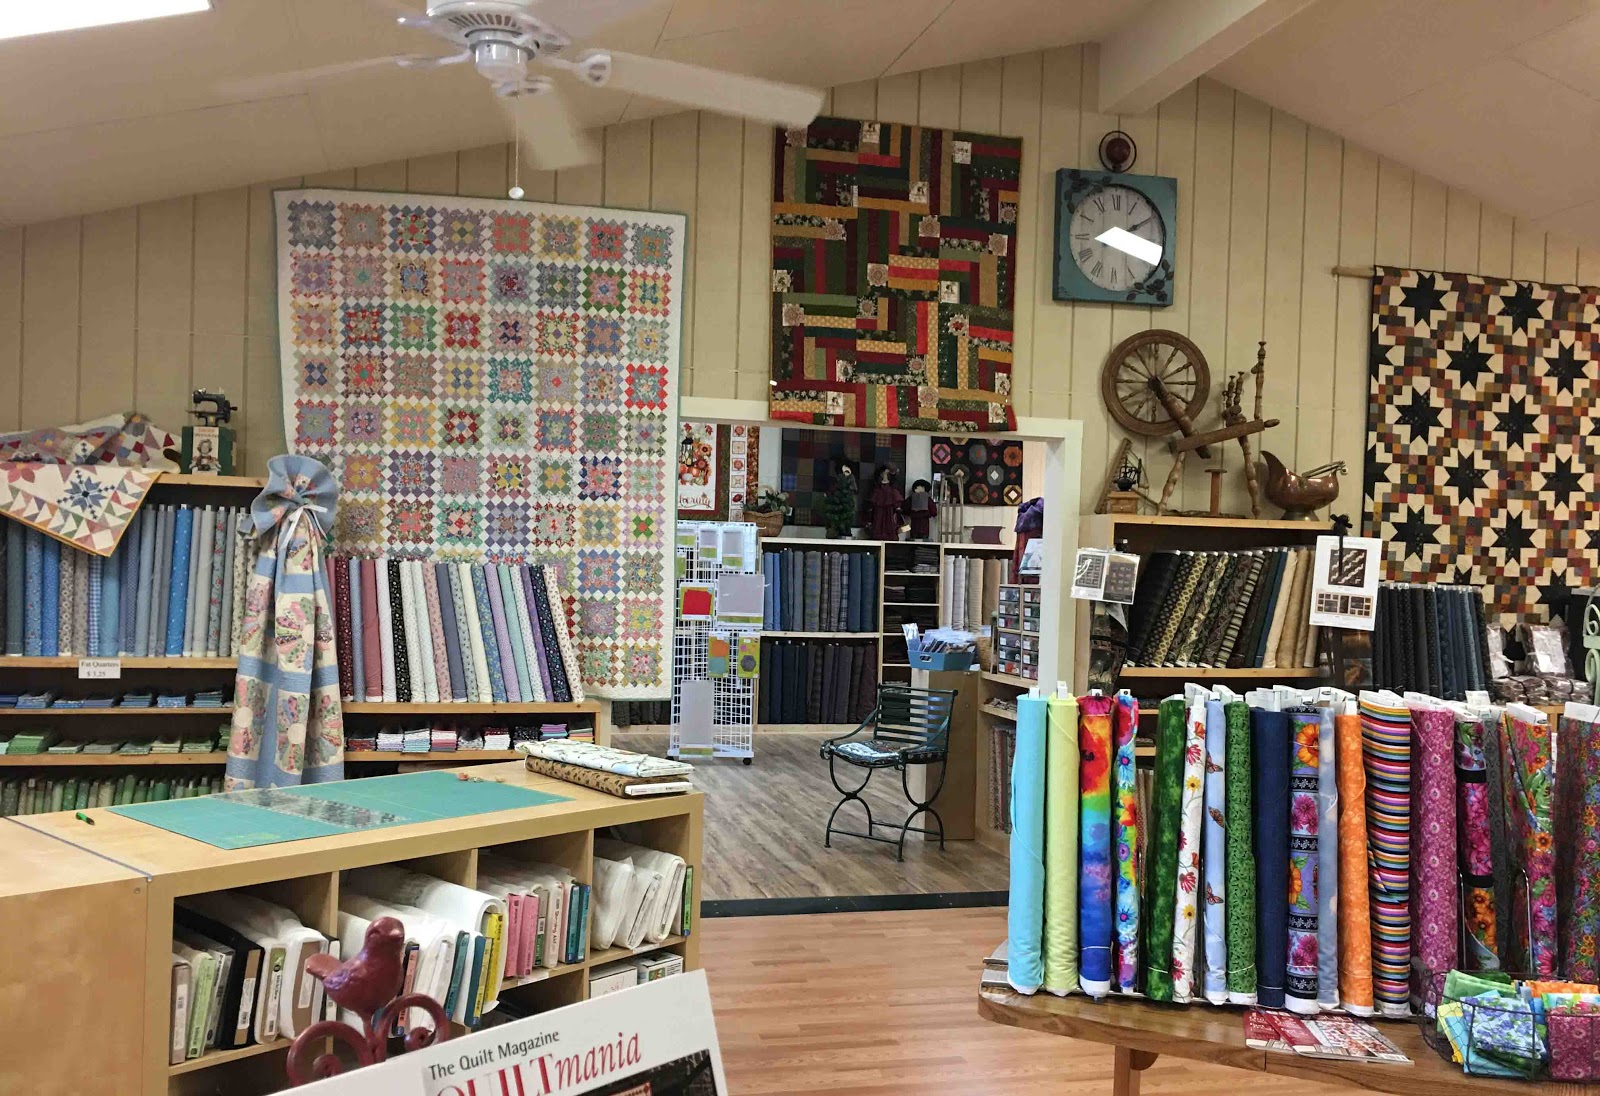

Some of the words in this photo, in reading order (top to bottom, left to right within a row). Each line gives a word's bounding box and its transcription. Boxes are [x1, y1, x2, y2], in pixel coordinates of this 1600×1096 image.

[428, 1063, 455, 1080] The
[459, 1050, 494, 1070] Quilt
[498, 1029, 561, 1057] Magazine
[437, 1032, 641, 1096] ILTmania
